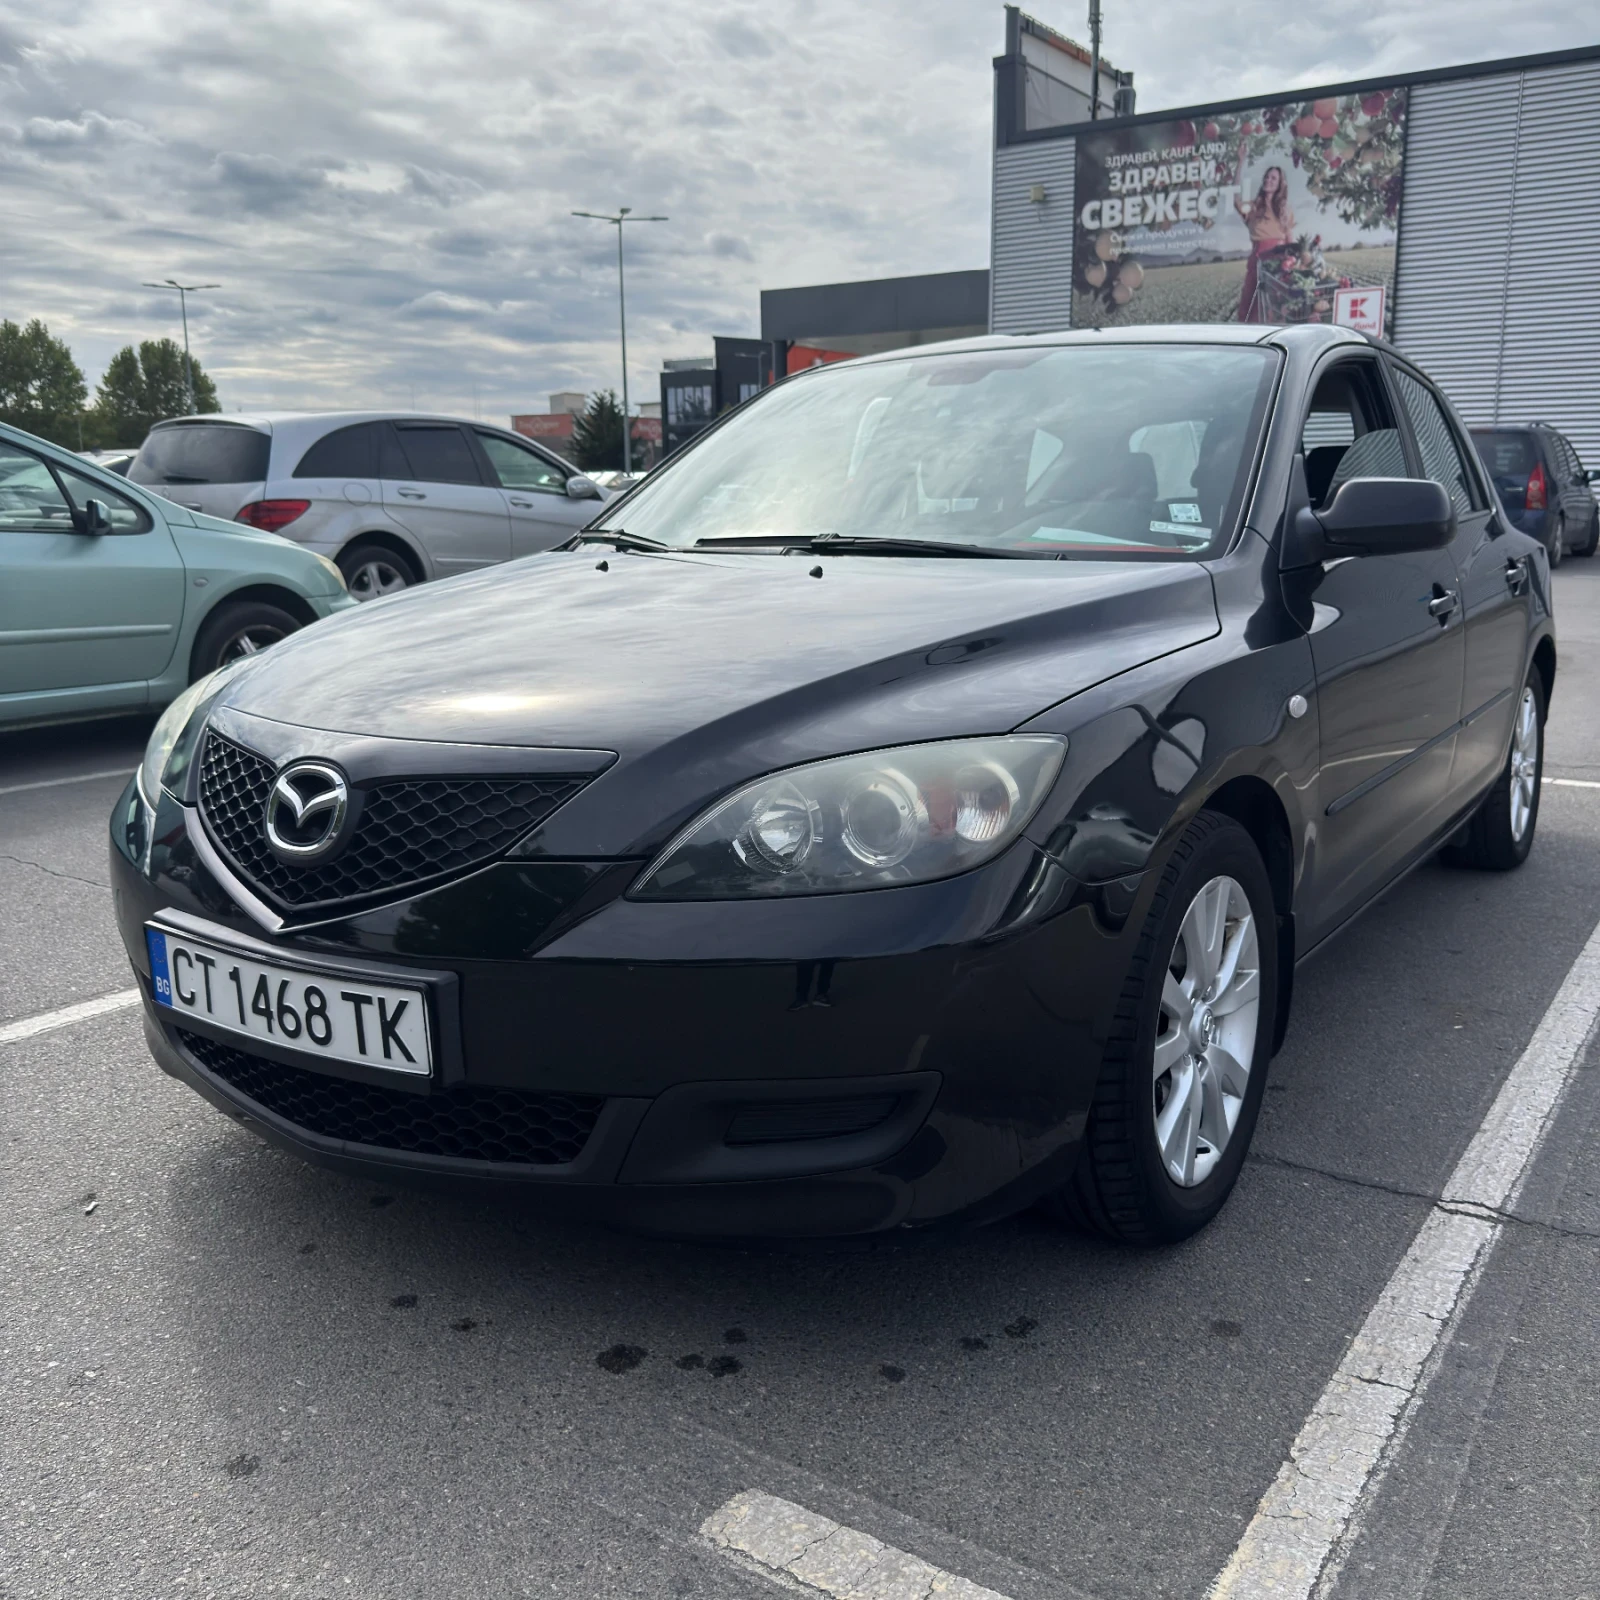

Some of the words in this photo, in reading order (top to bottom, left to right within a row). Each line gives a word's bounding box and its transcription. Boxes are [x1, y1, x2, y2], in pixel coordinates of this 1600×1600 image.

[1108, 154, 1221, 194] ЗДРАВЕЙ,
[1081, 178, 1252, 230] СВЕЖЕСТ!
[156, 975, 170, 996] BG
[172, 946, 216, 1014] CT
[228, 965, 333, 1046] 1468
[340, 990, 418, 1063] TK
